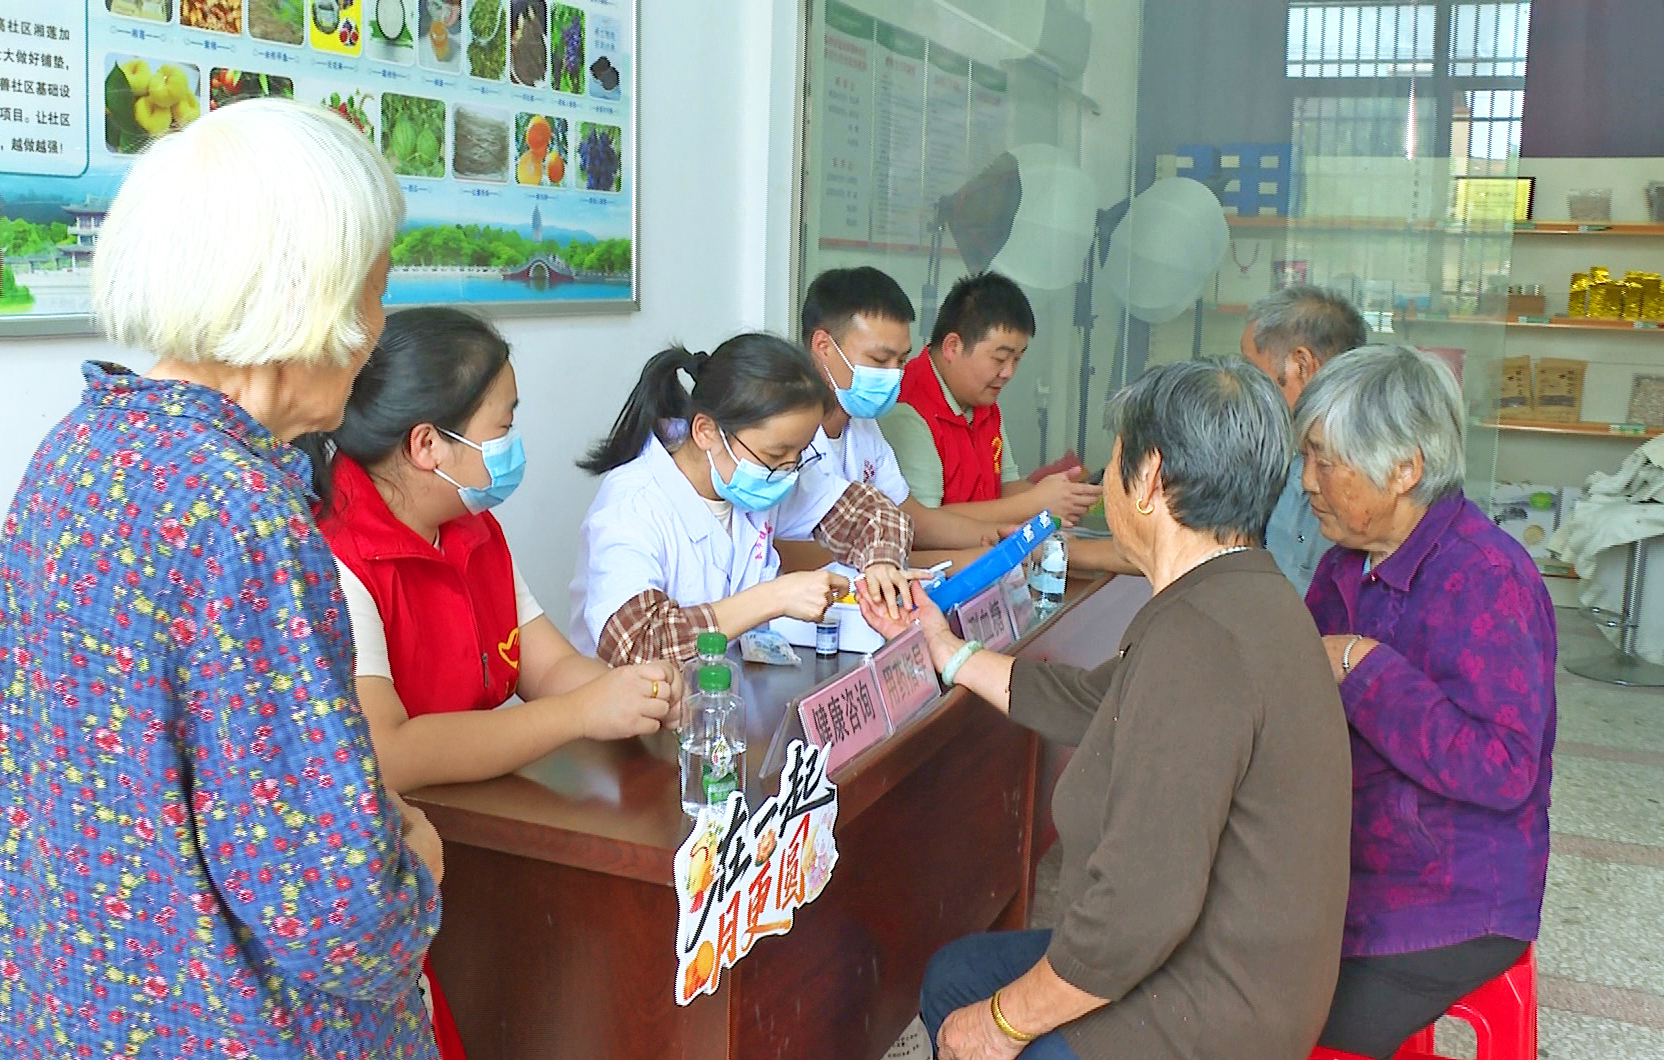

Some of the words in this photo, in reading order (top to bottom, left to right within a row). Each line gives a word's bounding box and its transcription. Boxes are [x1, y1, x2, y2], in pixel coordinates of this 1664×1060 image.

[0, 48, 69, 70] 大做好铺垫，
[812, 679, 876, 748] 健康咨询
[686, 744, 836, 954] 在一起
